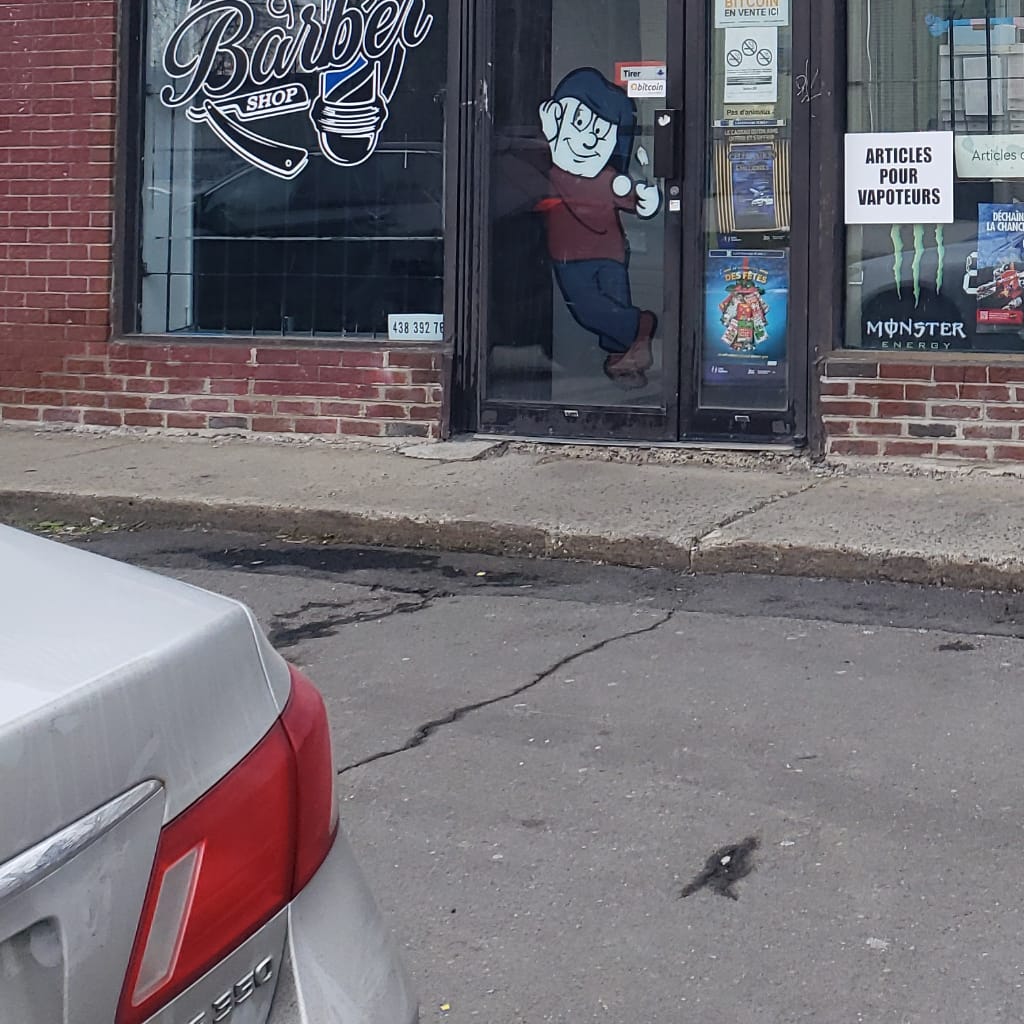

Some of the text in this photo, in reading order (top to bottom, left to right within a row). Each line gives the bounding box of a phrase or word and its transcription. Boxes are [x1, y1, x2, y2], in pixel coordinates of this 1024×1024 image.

[724, 7, 779, 17] EN VENTE ICI
[623, 69, 641, 78] Tirer
[637, 82, 664, 92] bitcoin
[246, 86, 299, 112] SHOP
[865, 146, 933, 165] ARTICLES
[971, 148, 1017, 162] Articles
[879, 167, 918, 185] POUR
[858, 188, 941, 206] VAPOTEURS
[986, 222, 995, 232] LA
[392, 321, 409, 334] 438
[413, 321, 430, 334] 392
[866, 318, 967, 338] MONSTER
[881, 341, 951, 350] ENERGY
